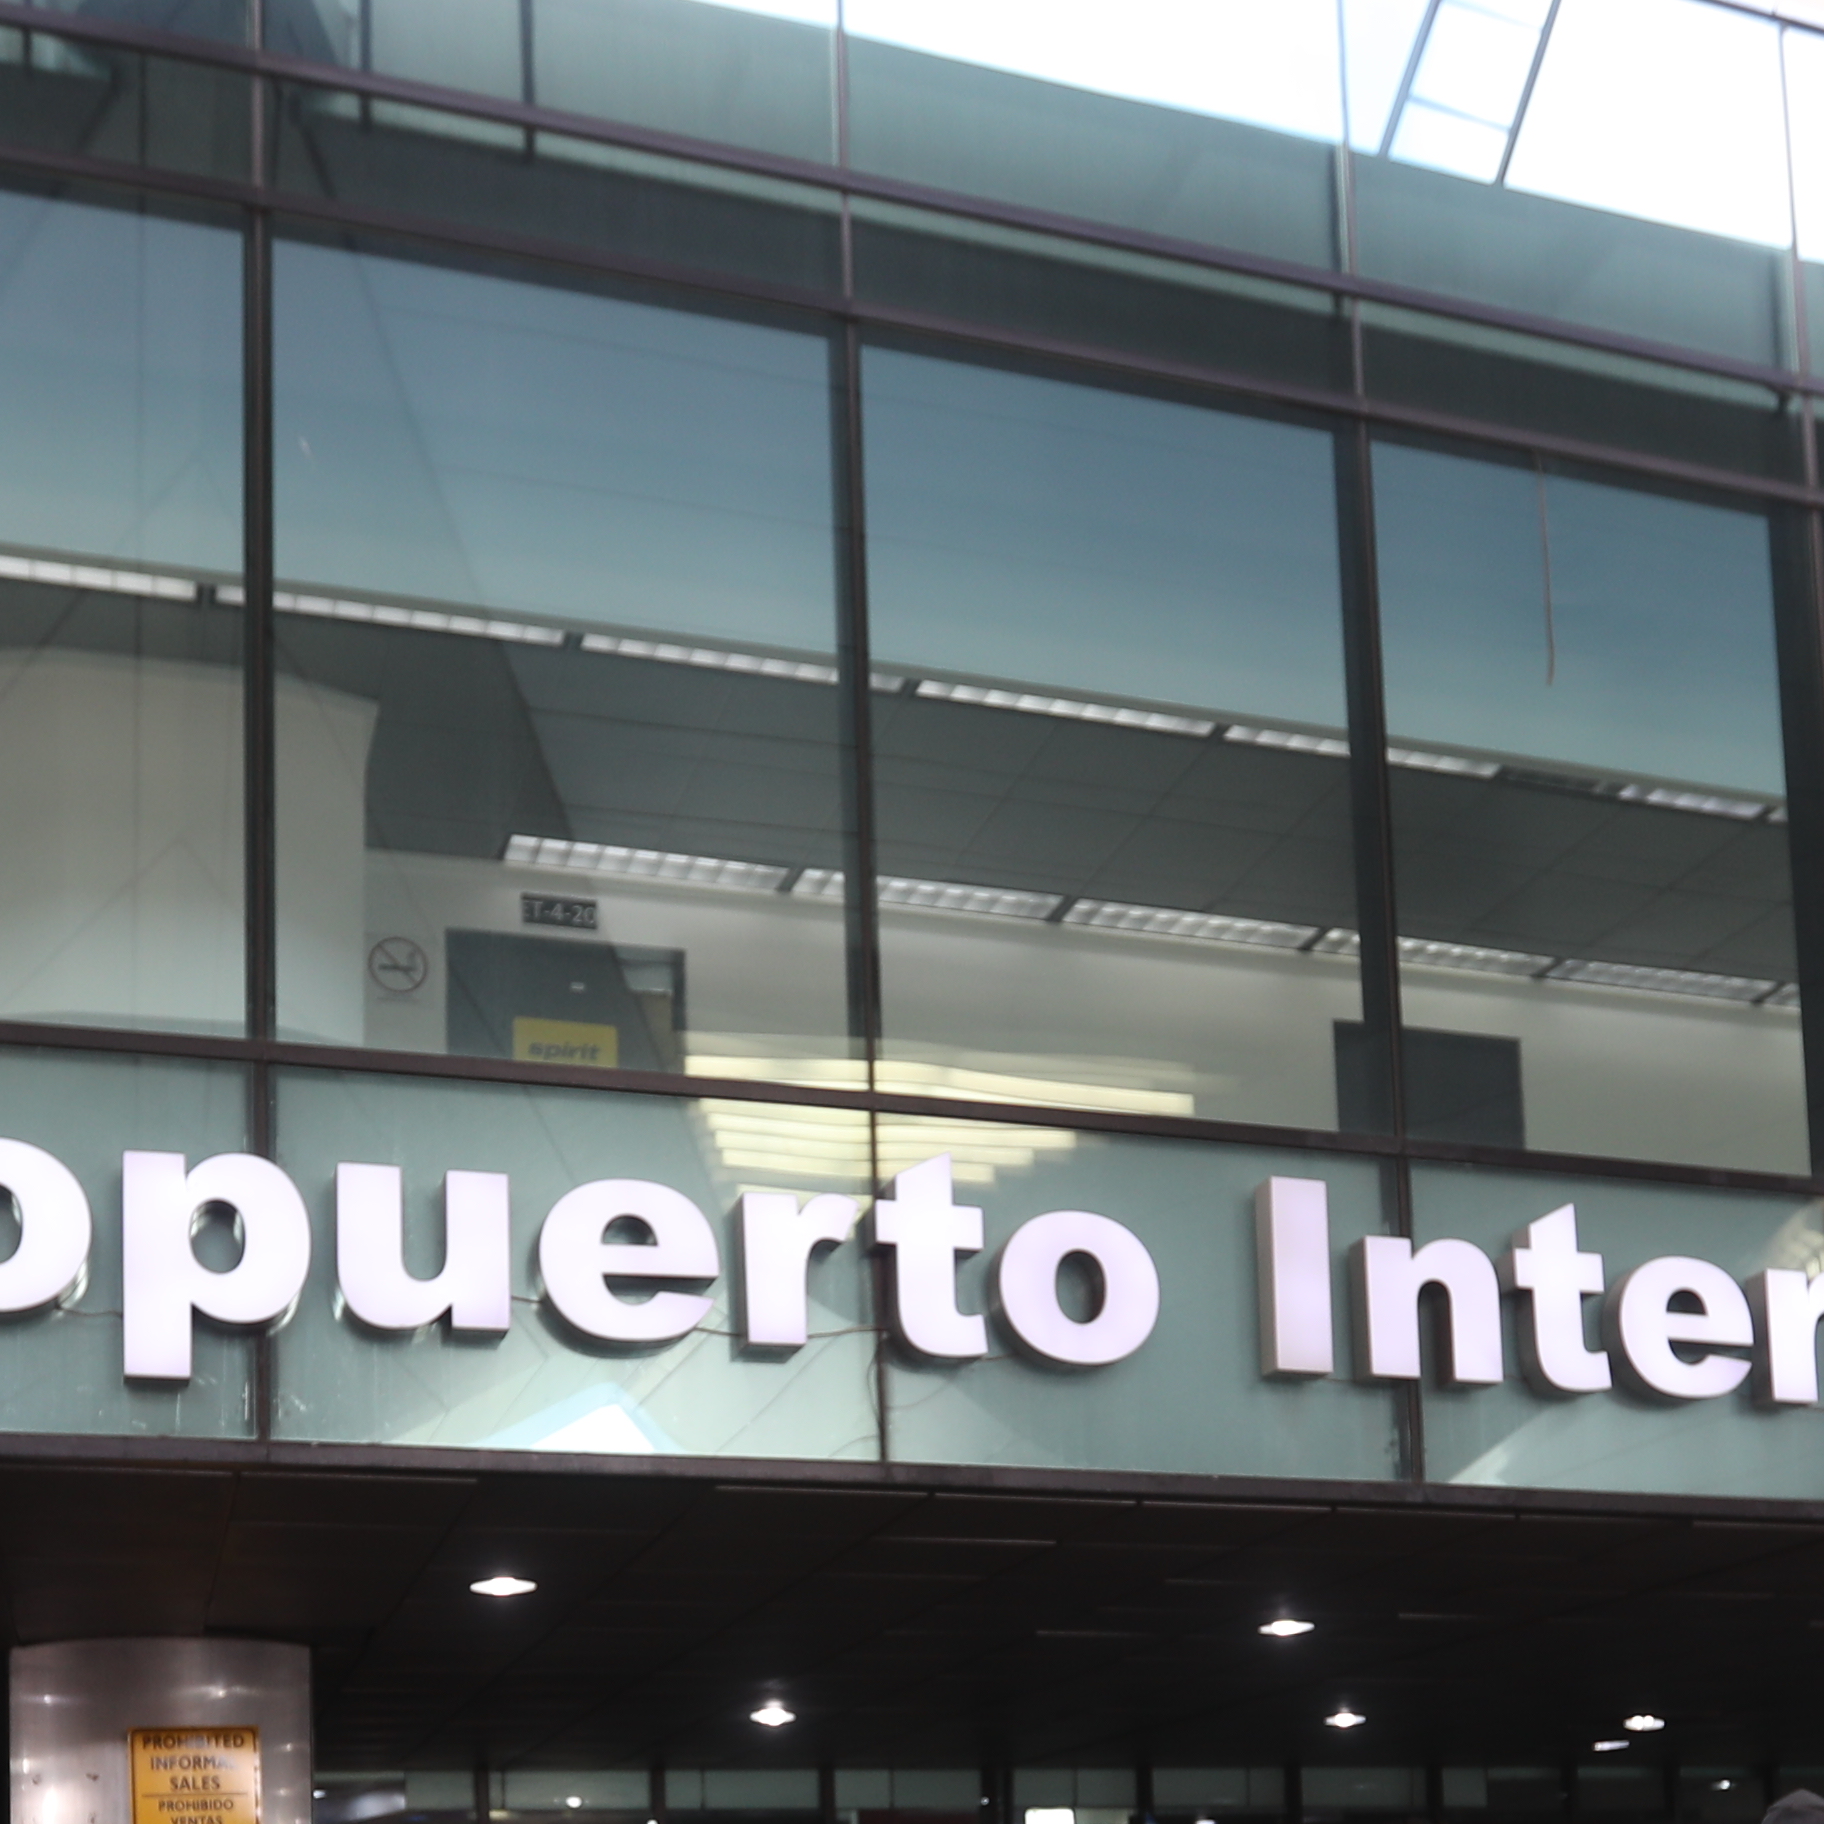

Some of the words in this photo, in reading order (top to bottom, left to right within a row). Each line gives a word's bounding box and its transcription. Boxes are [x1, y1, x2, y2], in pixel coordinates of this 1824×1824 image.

[528, 1041, 600, 1060] spirit
[170, 1775, 220, 1791] SALES
[158, 1799, 234, 1812] PROHIBIDO
